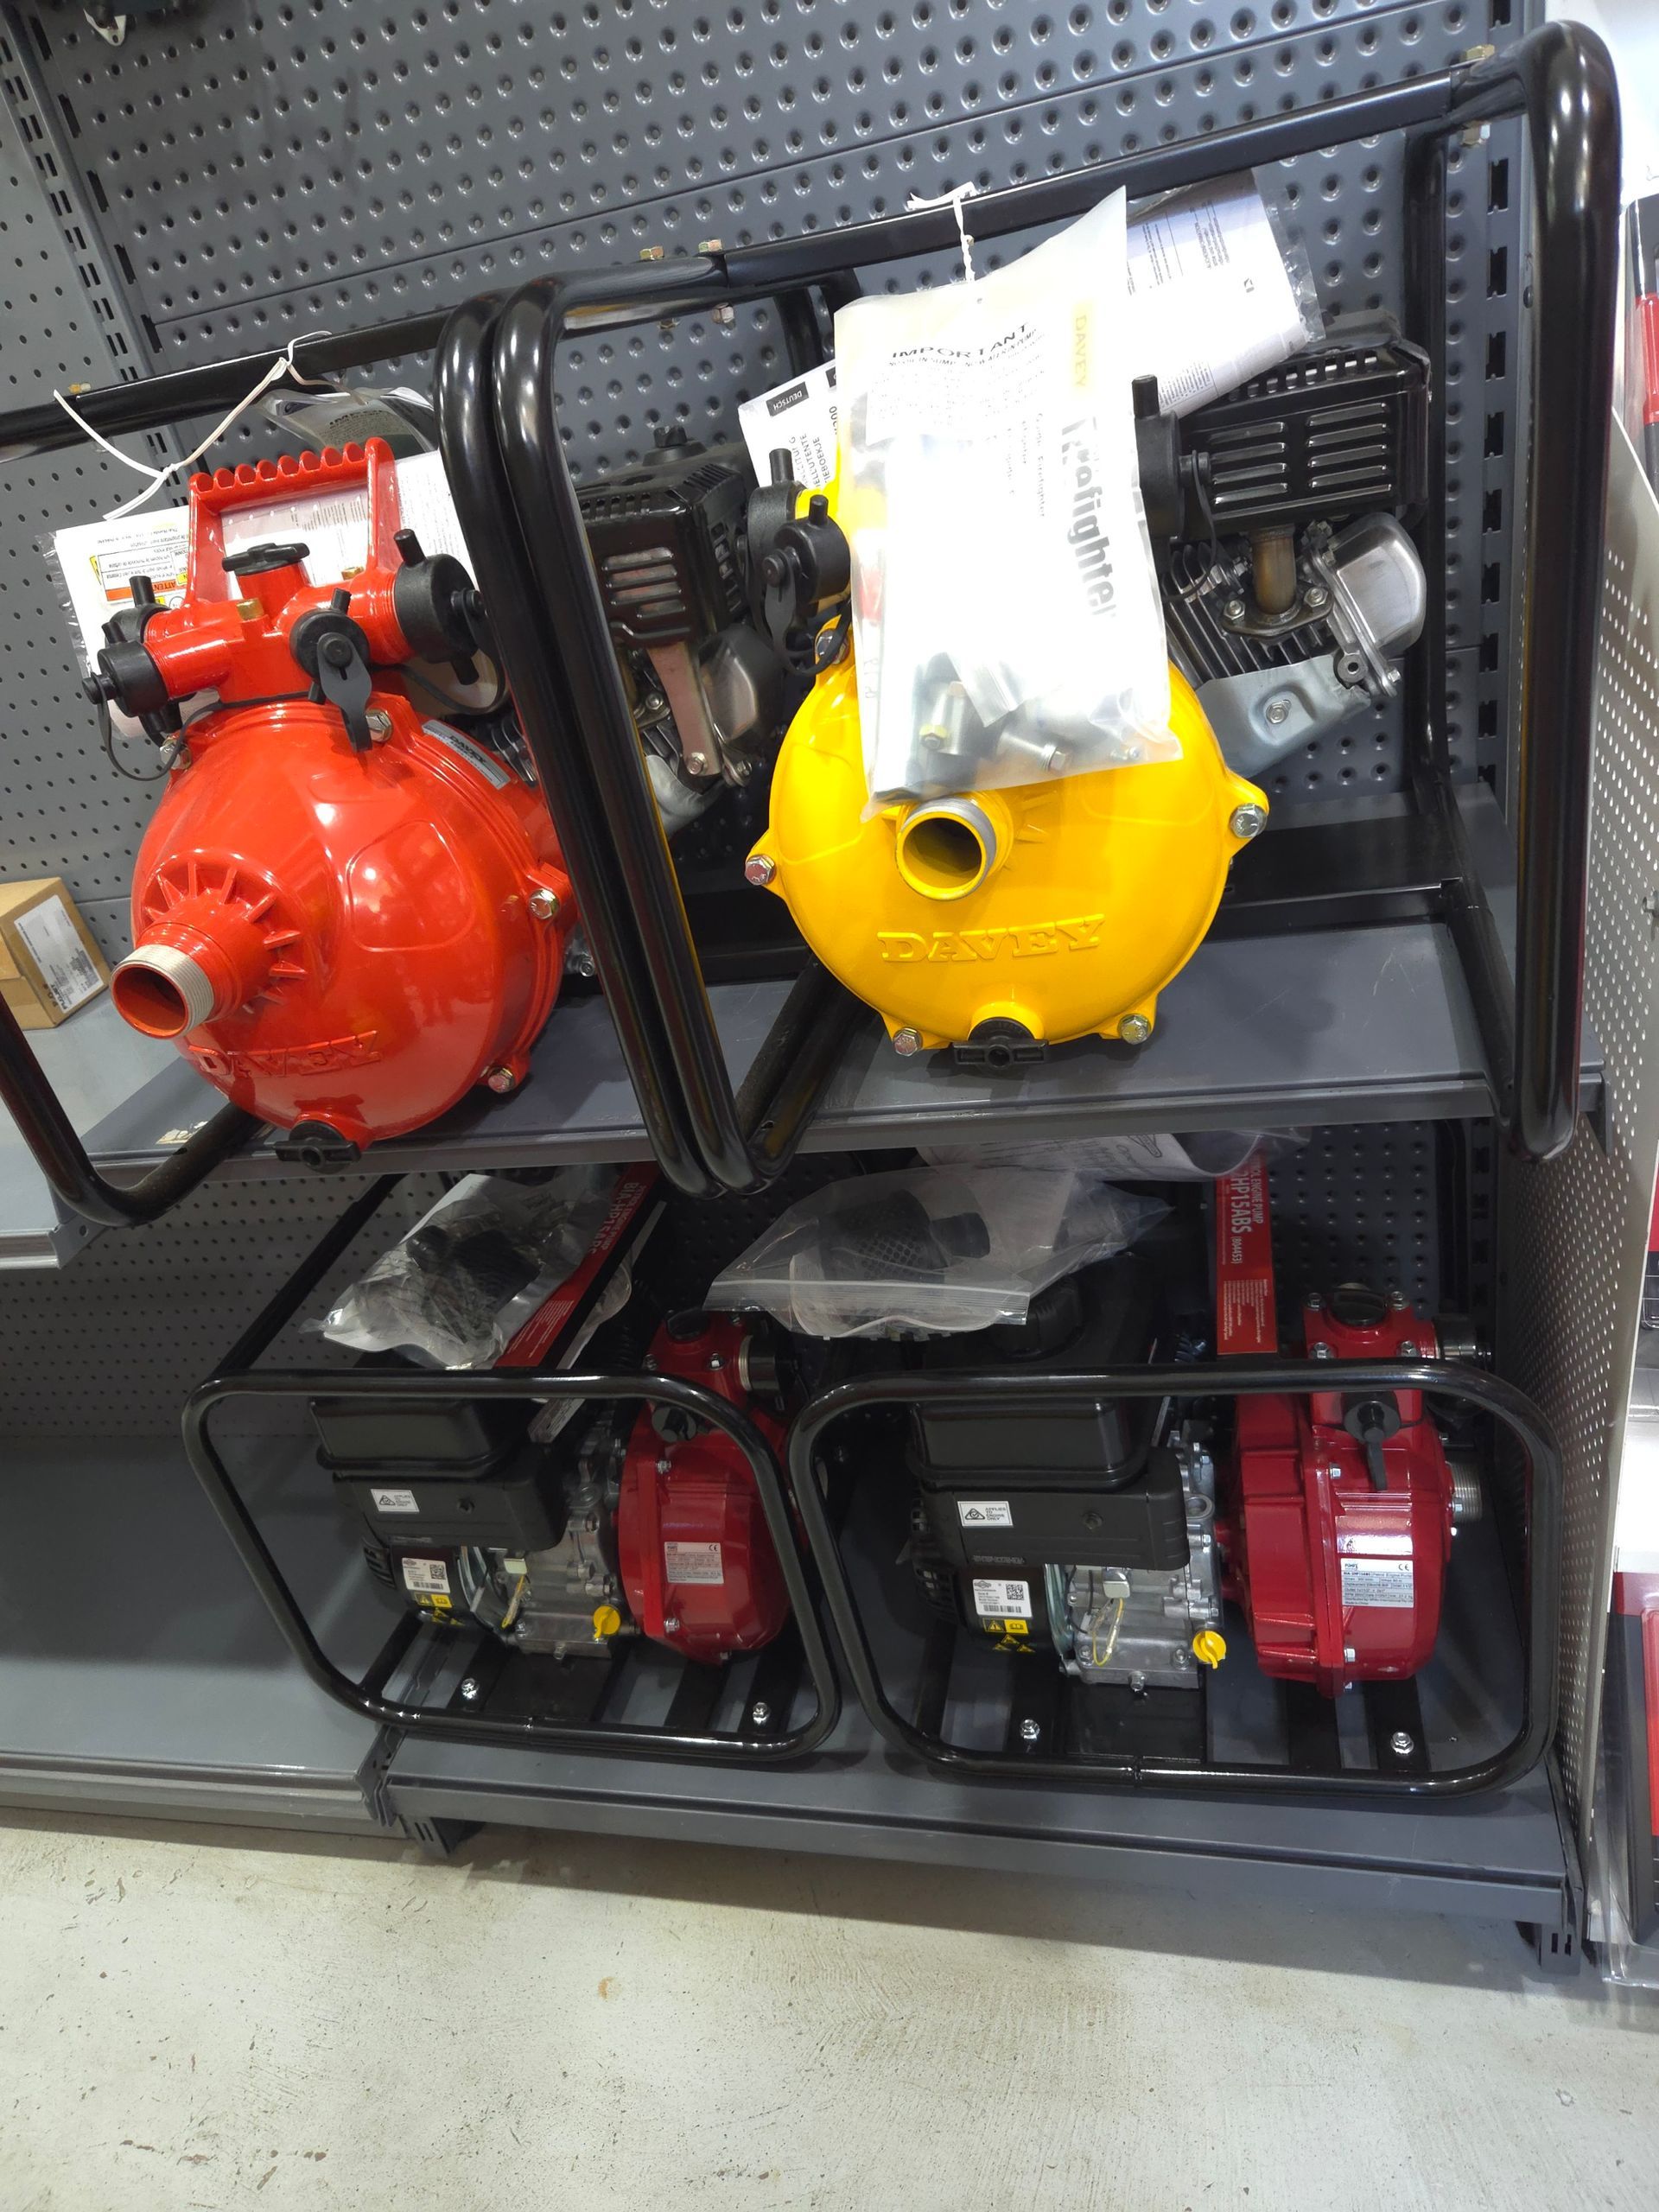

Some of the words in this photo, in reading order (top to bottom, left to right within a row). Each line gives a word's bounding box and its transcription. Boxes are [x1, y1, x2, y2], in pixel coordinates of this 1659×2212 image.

[892, 321, 1029, 359] IMPORTANT
[1075, 315, 1087, 388] DAVEY
[772, 390, 803, 411] DEUTSCH
[877, 913, 1106, 962] DAVEY
[188, 1030, 381, 1078] DAVEY
[1251, 1178, 1263, 1203] ENGINE
[1252, 1203, 1264, 1224] PUMP
